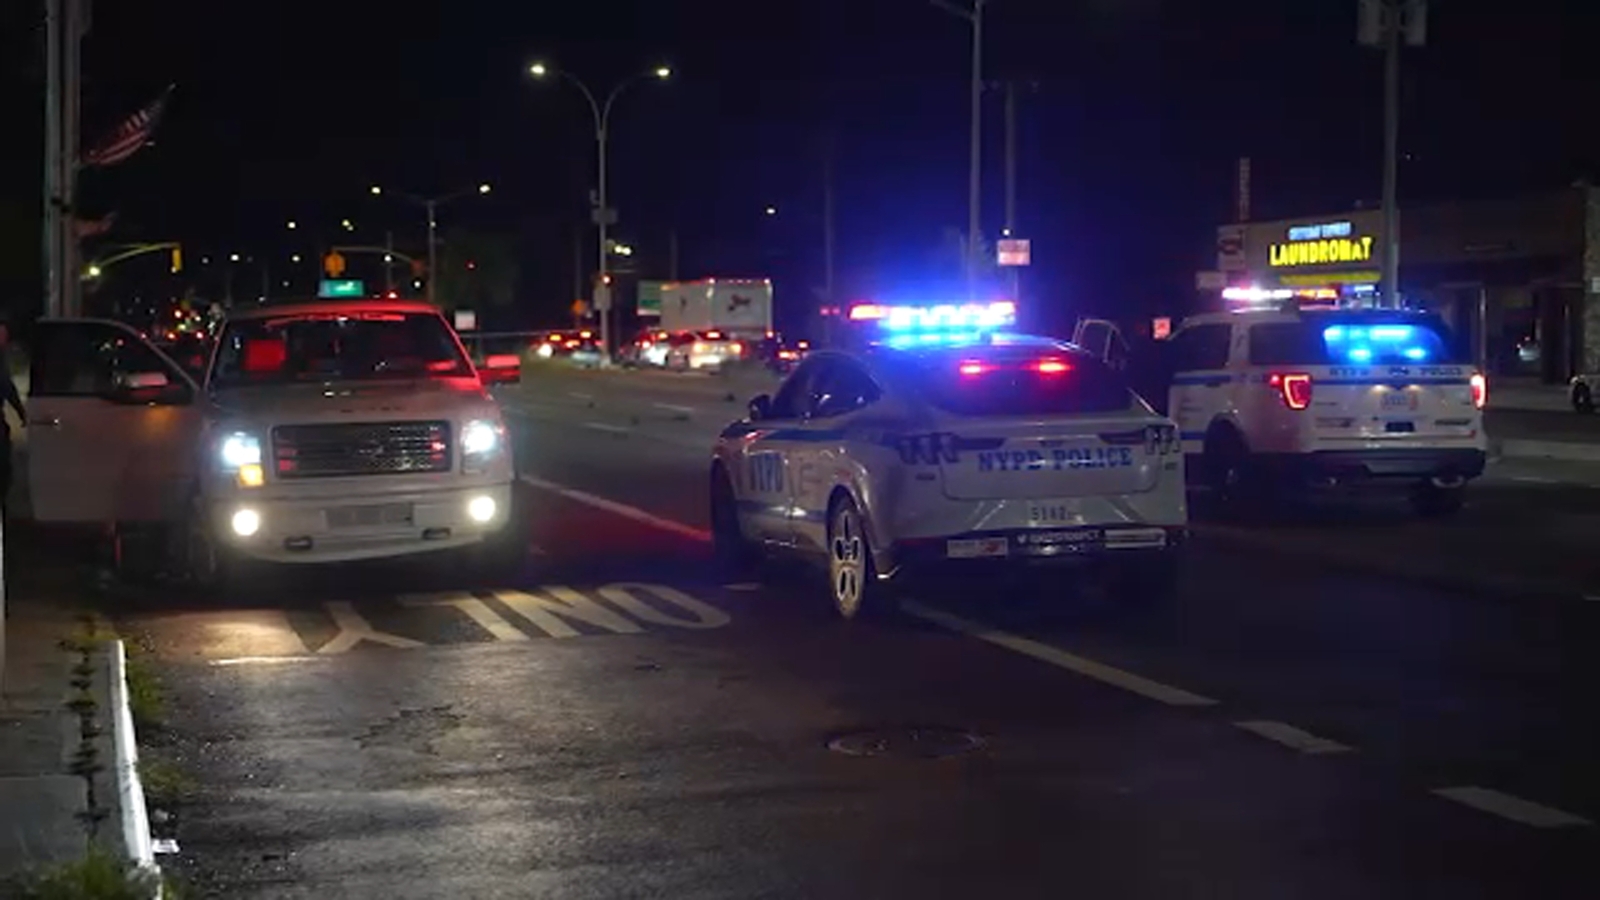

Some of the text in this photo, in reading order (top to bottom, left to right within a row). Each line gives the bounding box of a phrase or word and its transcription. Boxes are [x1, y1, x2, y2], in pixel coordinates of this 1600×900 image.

[1269, 236, 1372, 267] LAUNDROMAT
[977, 447, 1133, 472] NYPD POLICE
[316, 582, 731, 655] ONLY
